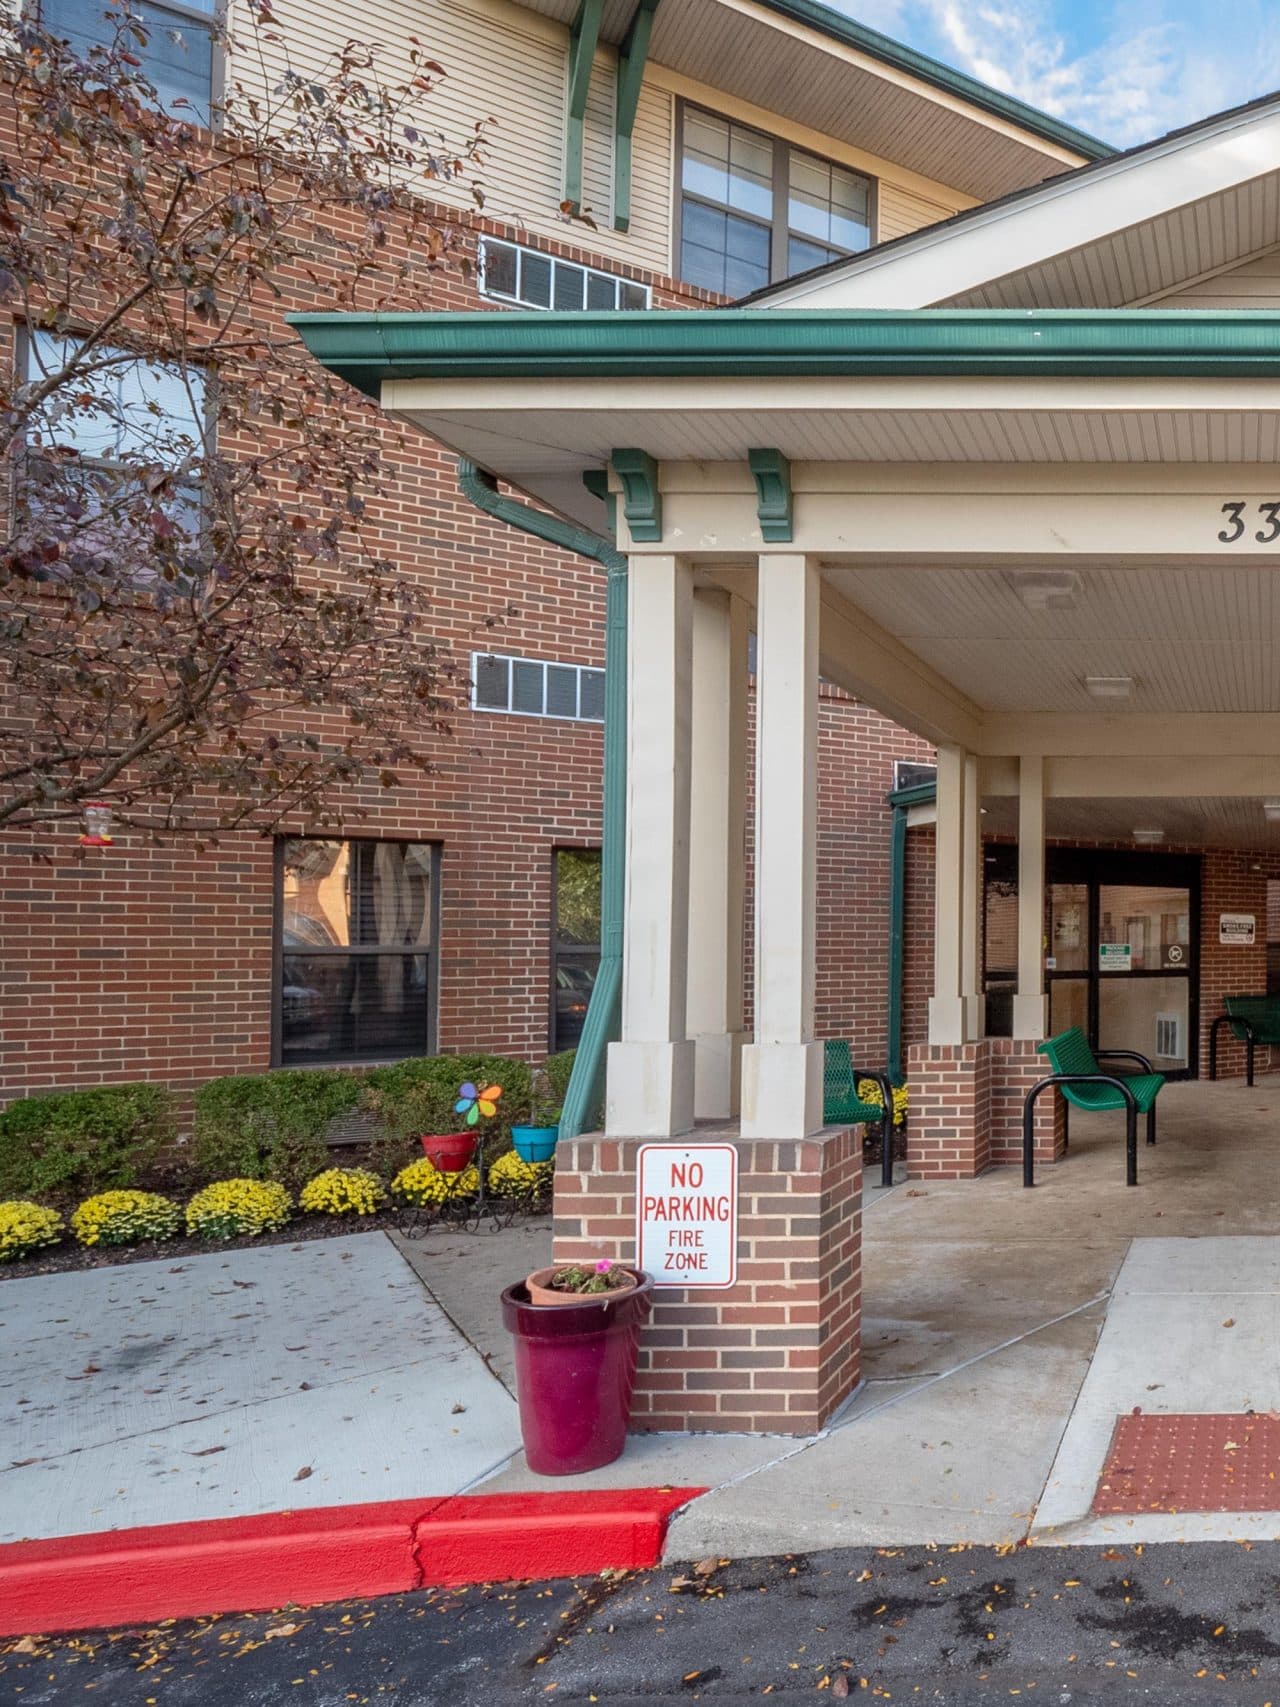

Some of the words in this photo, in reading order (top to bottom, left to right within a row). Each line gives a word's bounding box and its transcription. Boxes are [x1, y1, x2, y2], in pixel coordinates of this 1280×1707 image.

[671, 1162, 704, 1189] NO
[644, 1196, 730, 1222] PARKING
[668, 1230, 705, 1248] FIRE
[664, 1252, 709, 1270] ZONE
